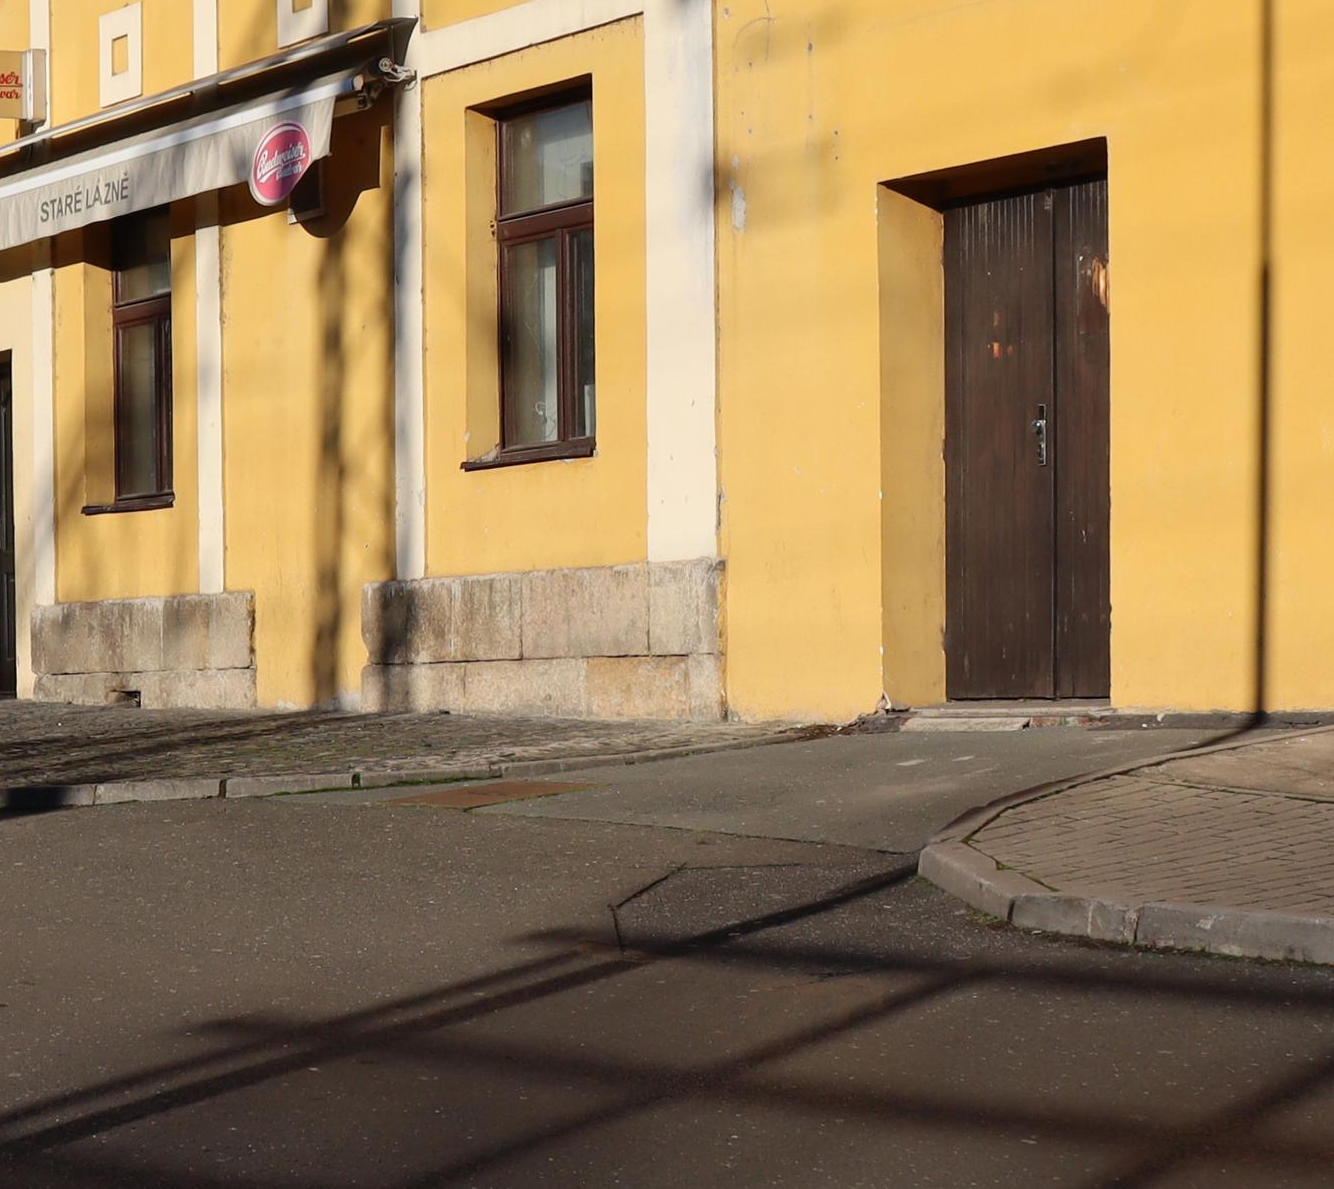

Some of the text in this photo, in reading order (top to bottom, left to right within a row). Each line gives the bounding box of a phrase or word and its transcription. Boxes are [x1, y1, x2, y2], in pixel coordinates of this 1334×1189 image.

[257, 142, 306, 183] Budweiser
[40, 171, 129, 223] STARÉ LÁZNĚ
